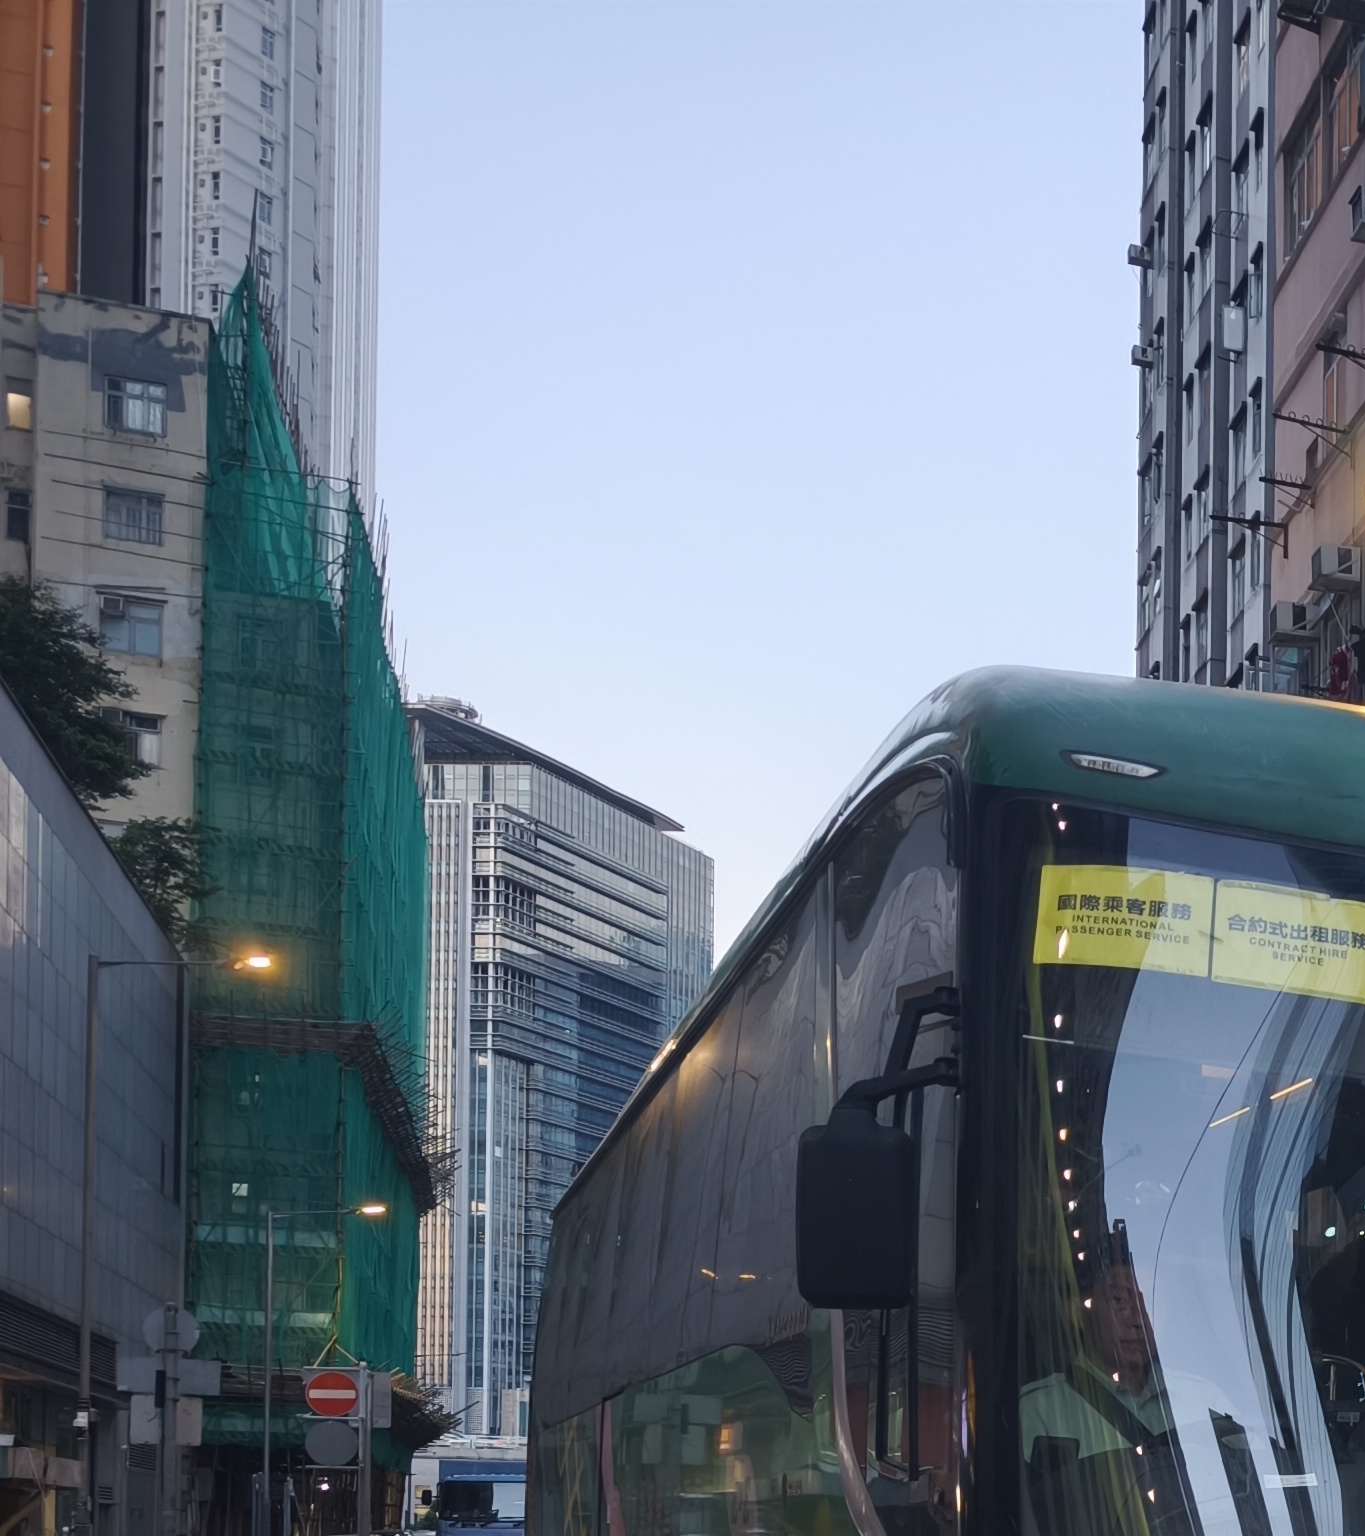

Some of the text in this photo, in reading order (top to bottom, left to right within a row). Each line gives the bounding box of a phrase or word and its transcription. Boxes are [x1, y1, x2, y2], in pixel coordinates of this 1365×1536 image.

[1072, 913, 1174, 932] INTERNATIONAL
[1135, 930, 1190, 945] SERVICE
[1249, 937, 1348, 960] CONTRACT HIRE
[1272, 951, 1325, 967] SERVICE
